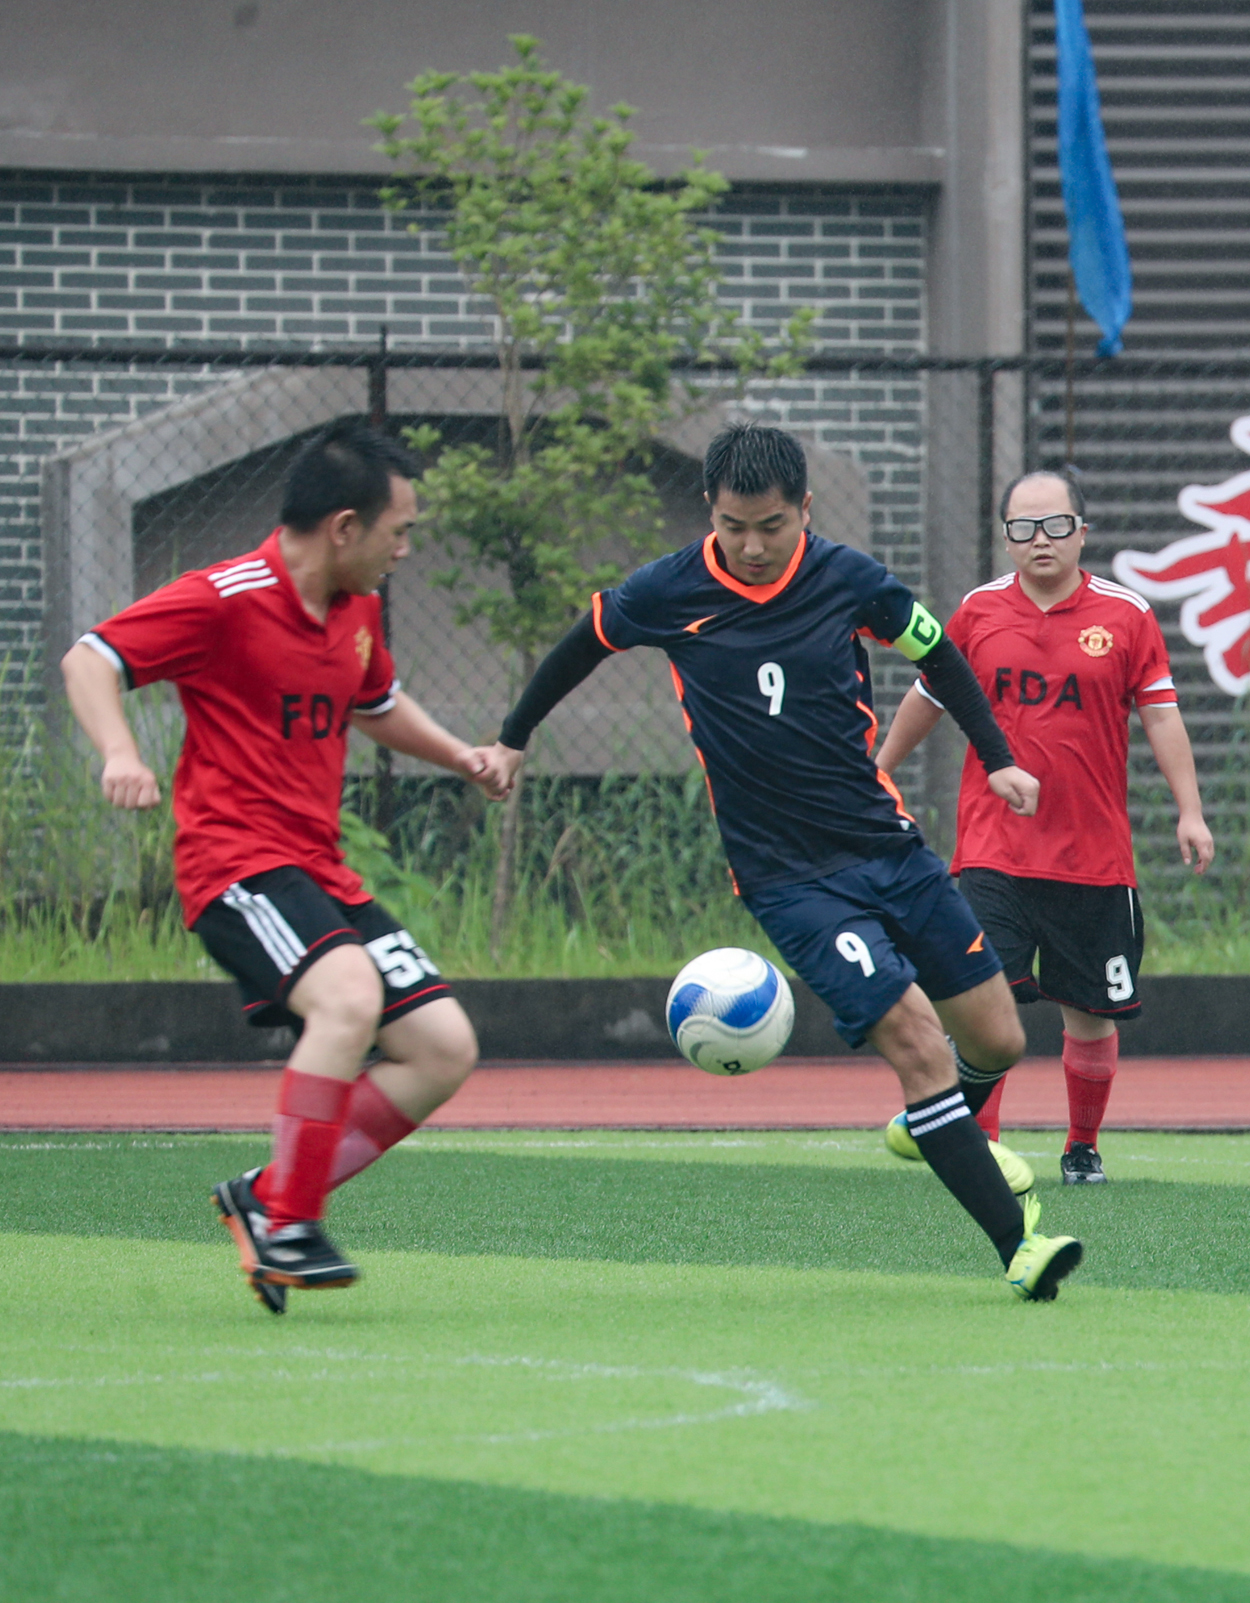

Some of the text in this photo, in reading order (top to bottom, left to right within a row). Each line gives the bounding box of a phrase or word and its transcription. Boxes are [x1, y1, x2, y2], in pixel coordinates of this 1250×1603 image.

[911, 614, 937, 646] C
[757, 661, 785, 716] 9
[995, 667, 1083, 710] FDA
[835, 931, 876, 978] 9
[1105, 954, 1134, 1002] 9
